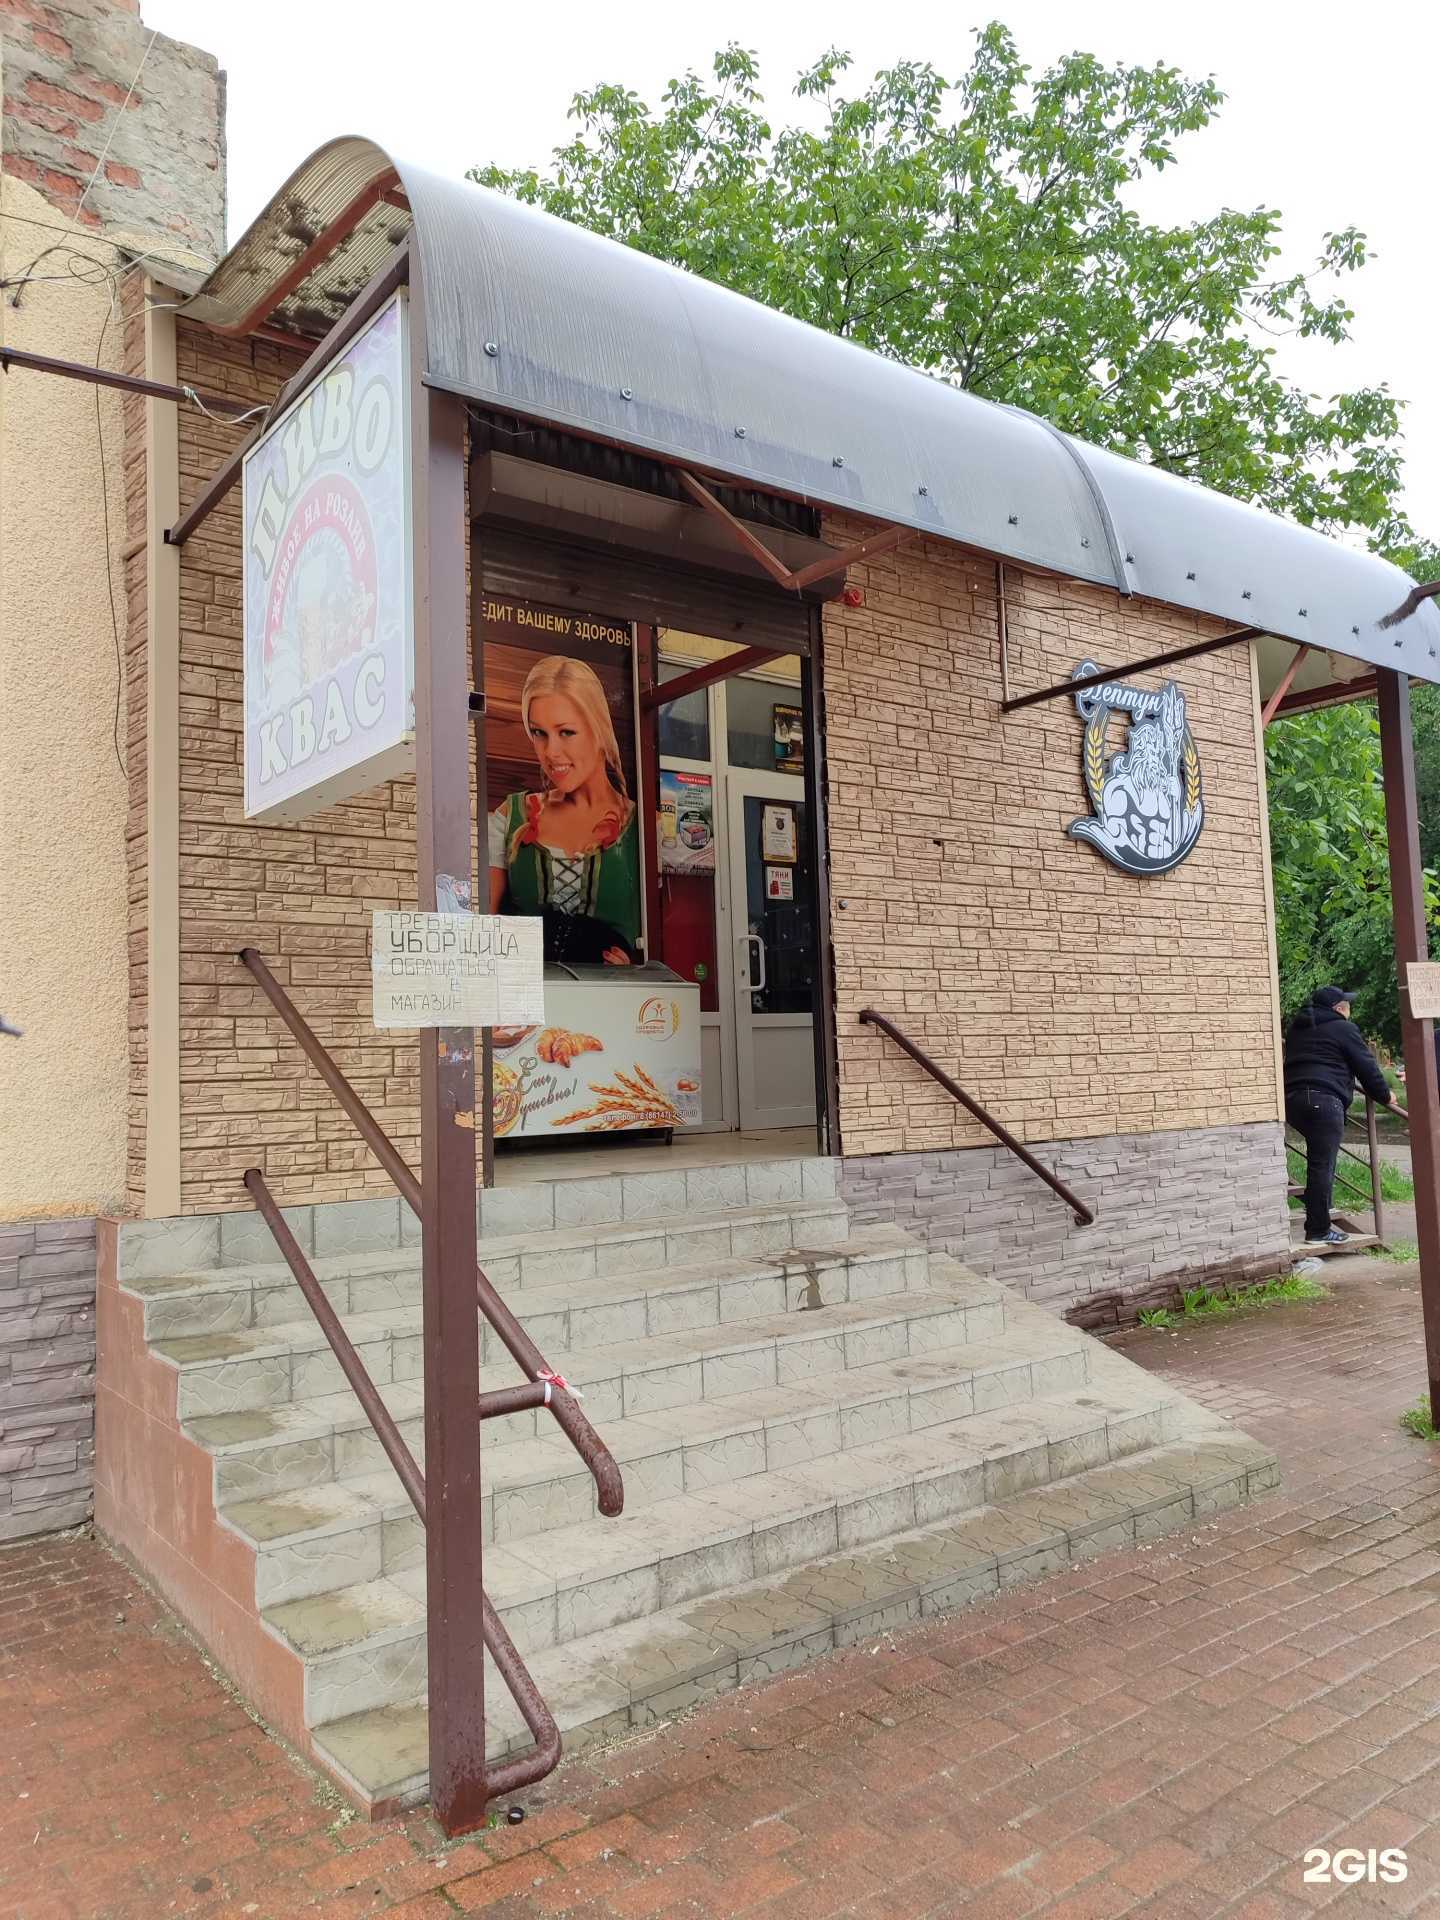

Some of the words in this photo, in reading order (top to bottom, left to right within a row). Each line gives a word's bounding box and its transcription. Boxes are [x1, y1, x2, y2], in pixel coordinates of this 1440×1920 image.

[251, 363, 393, 578] ПИВО
[271, 523, 303, 624] ЖИВОЕ
[304, 498, 321, 531] НА
[326, 492, 366, 561] РОЗЛИВ
[517, 608, 571, 634] ВАШЕМУ
[259, 655, 386, 785] КВАС
[770, 870, 789, 881] ТЯНИ
[391, 930, 519, 959] УБОРЩИЦА
[391, 957, 496, 978] ОБРАЩАТЬСЯ
[391, 994, 463, 1012] МАГАЗИН
